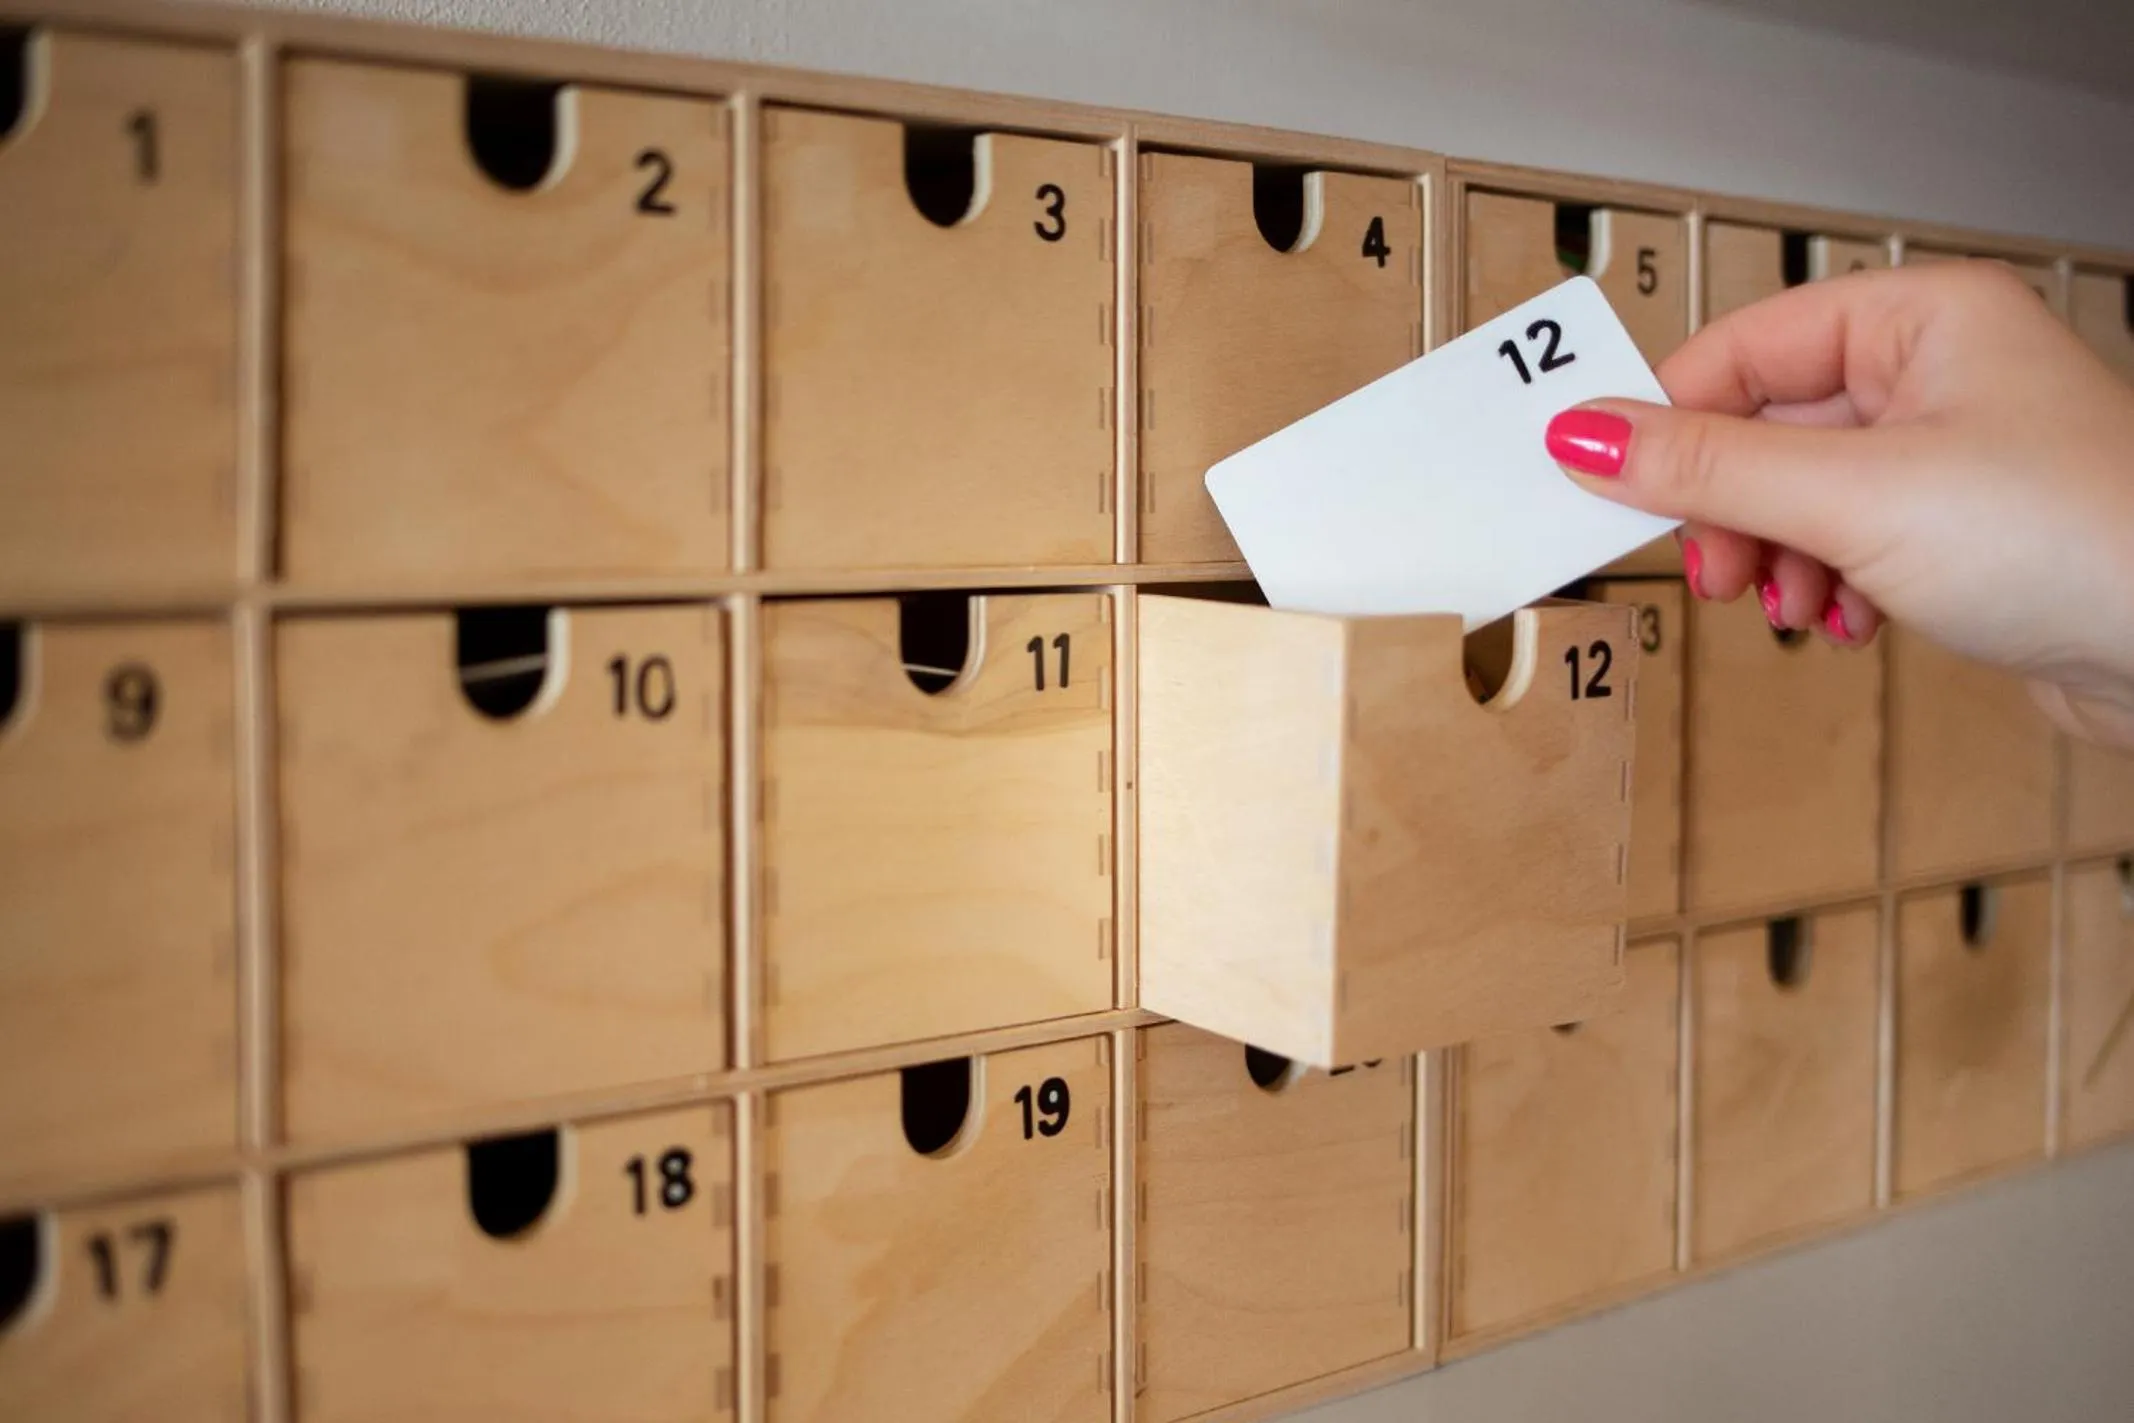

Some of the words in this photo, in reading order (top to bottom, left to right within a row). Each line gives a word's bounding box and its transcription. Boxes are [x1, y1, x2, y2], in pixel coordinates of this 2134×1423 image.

[127, 110, 158, 179] 1
[635, 149, 675, 216] 2
[1034, 182, 1067, 242] 3
[1361, 215, 1392, 269] 4
[1636, 246, 1659, 296] 5
[1498, 318, 1576, 385] 12
[1640, 603, 1661, 655] 3
[608, 654, 676, 721] 10
[1026, 633, 1071, 692] 11
[1564, 638, 1613, 701] 12
[107, 669, 158, 738] 9
[1014, 1076, 1072, 1141] 19
[625, 1147, 696, 1215] 18
[87, 1221, 174, 1298] 17
